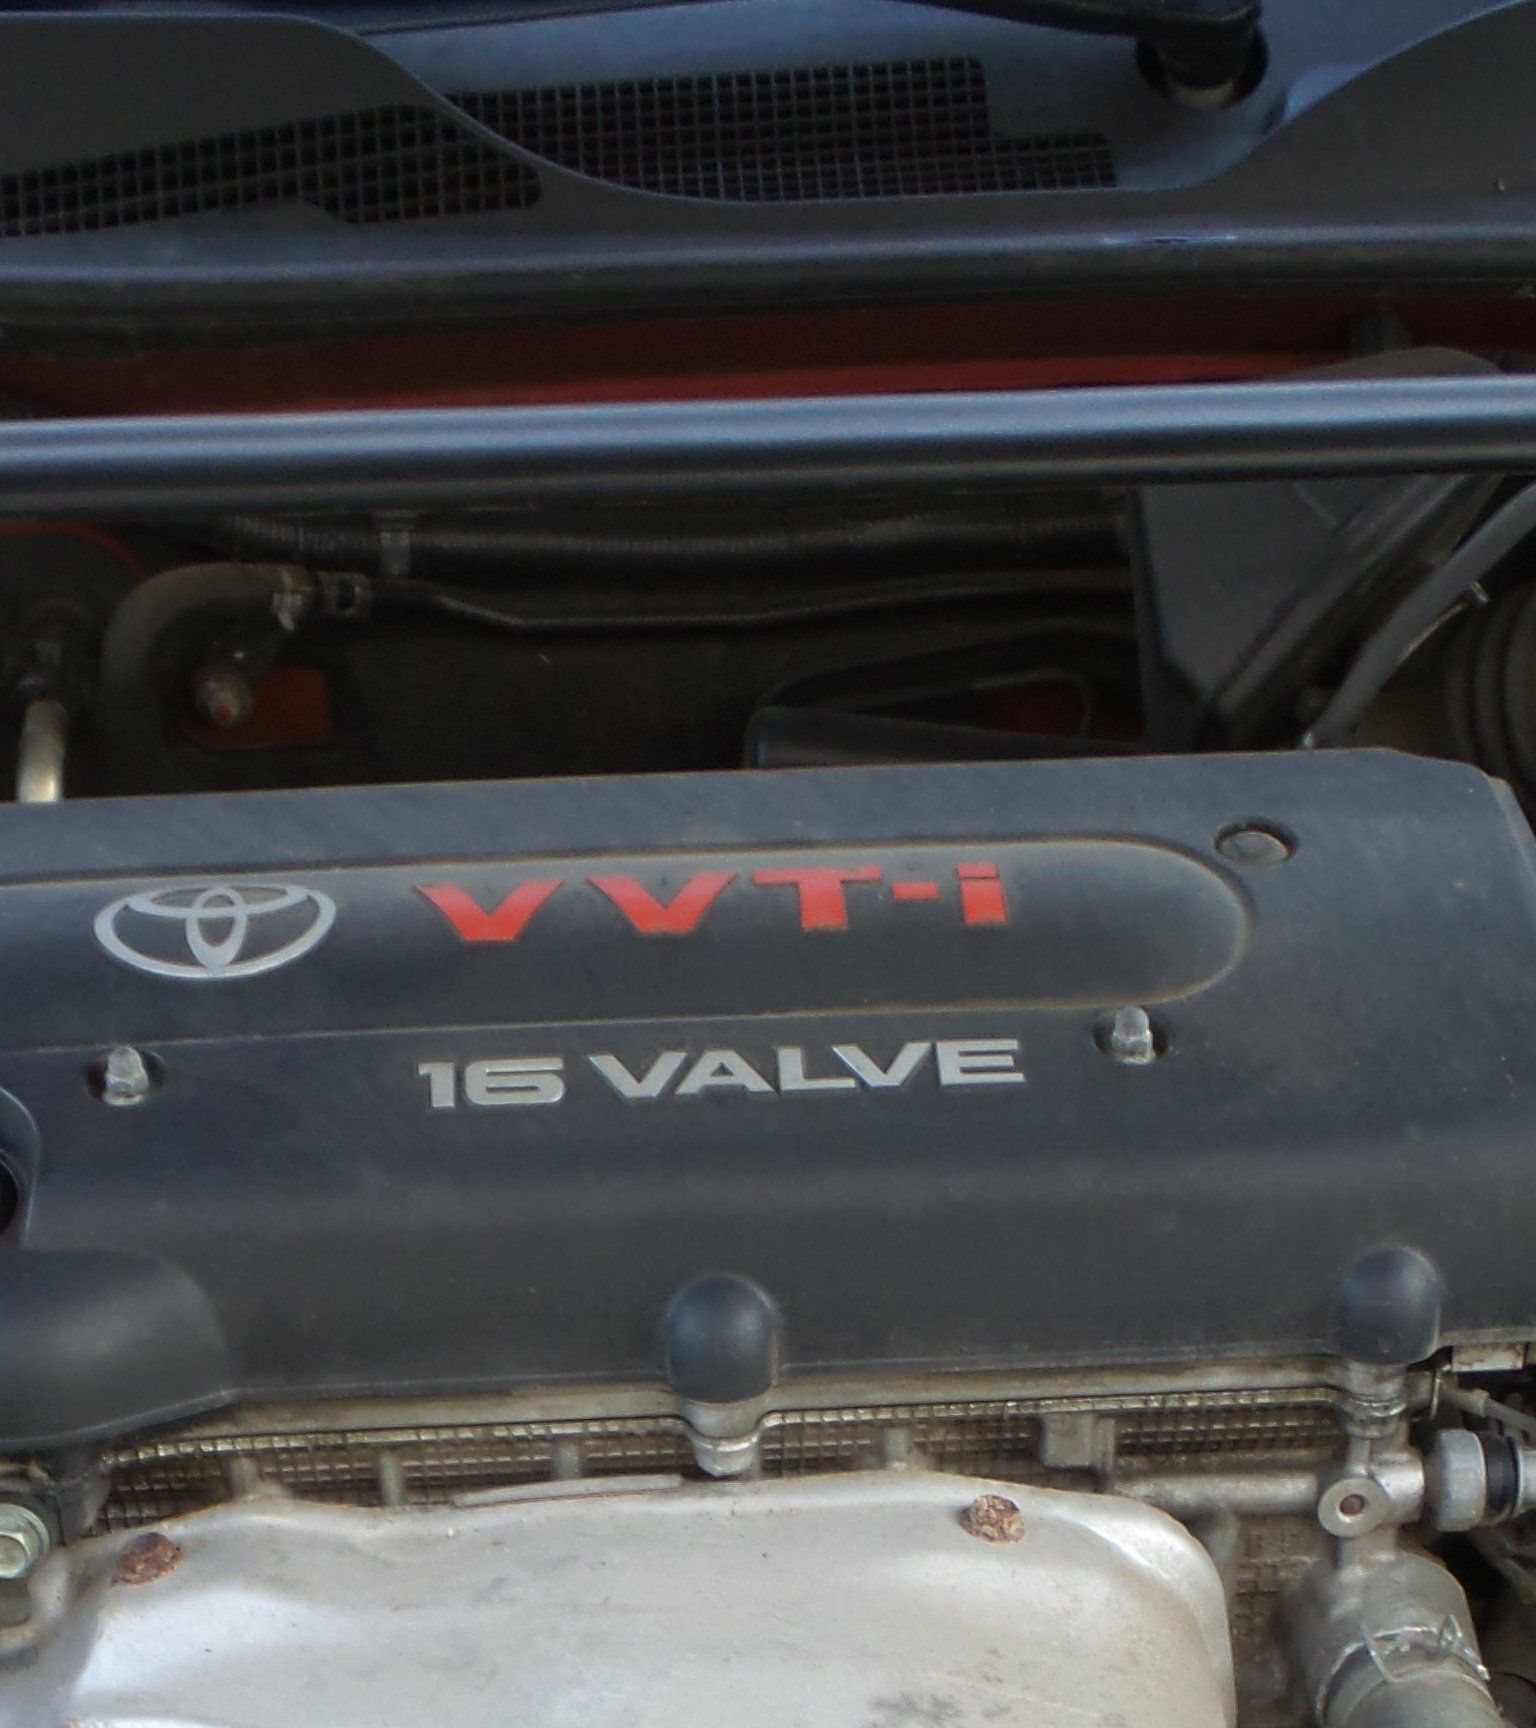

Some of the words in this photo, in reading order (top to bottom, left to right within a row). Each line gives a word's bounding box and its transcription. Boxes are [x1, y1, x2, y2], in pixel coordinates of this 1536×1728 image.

[415, 861, 1010, 943] VVT-i
[416, 1055, 566, 1108] 16
[587, 1037, 1026, 1101] VALVE
